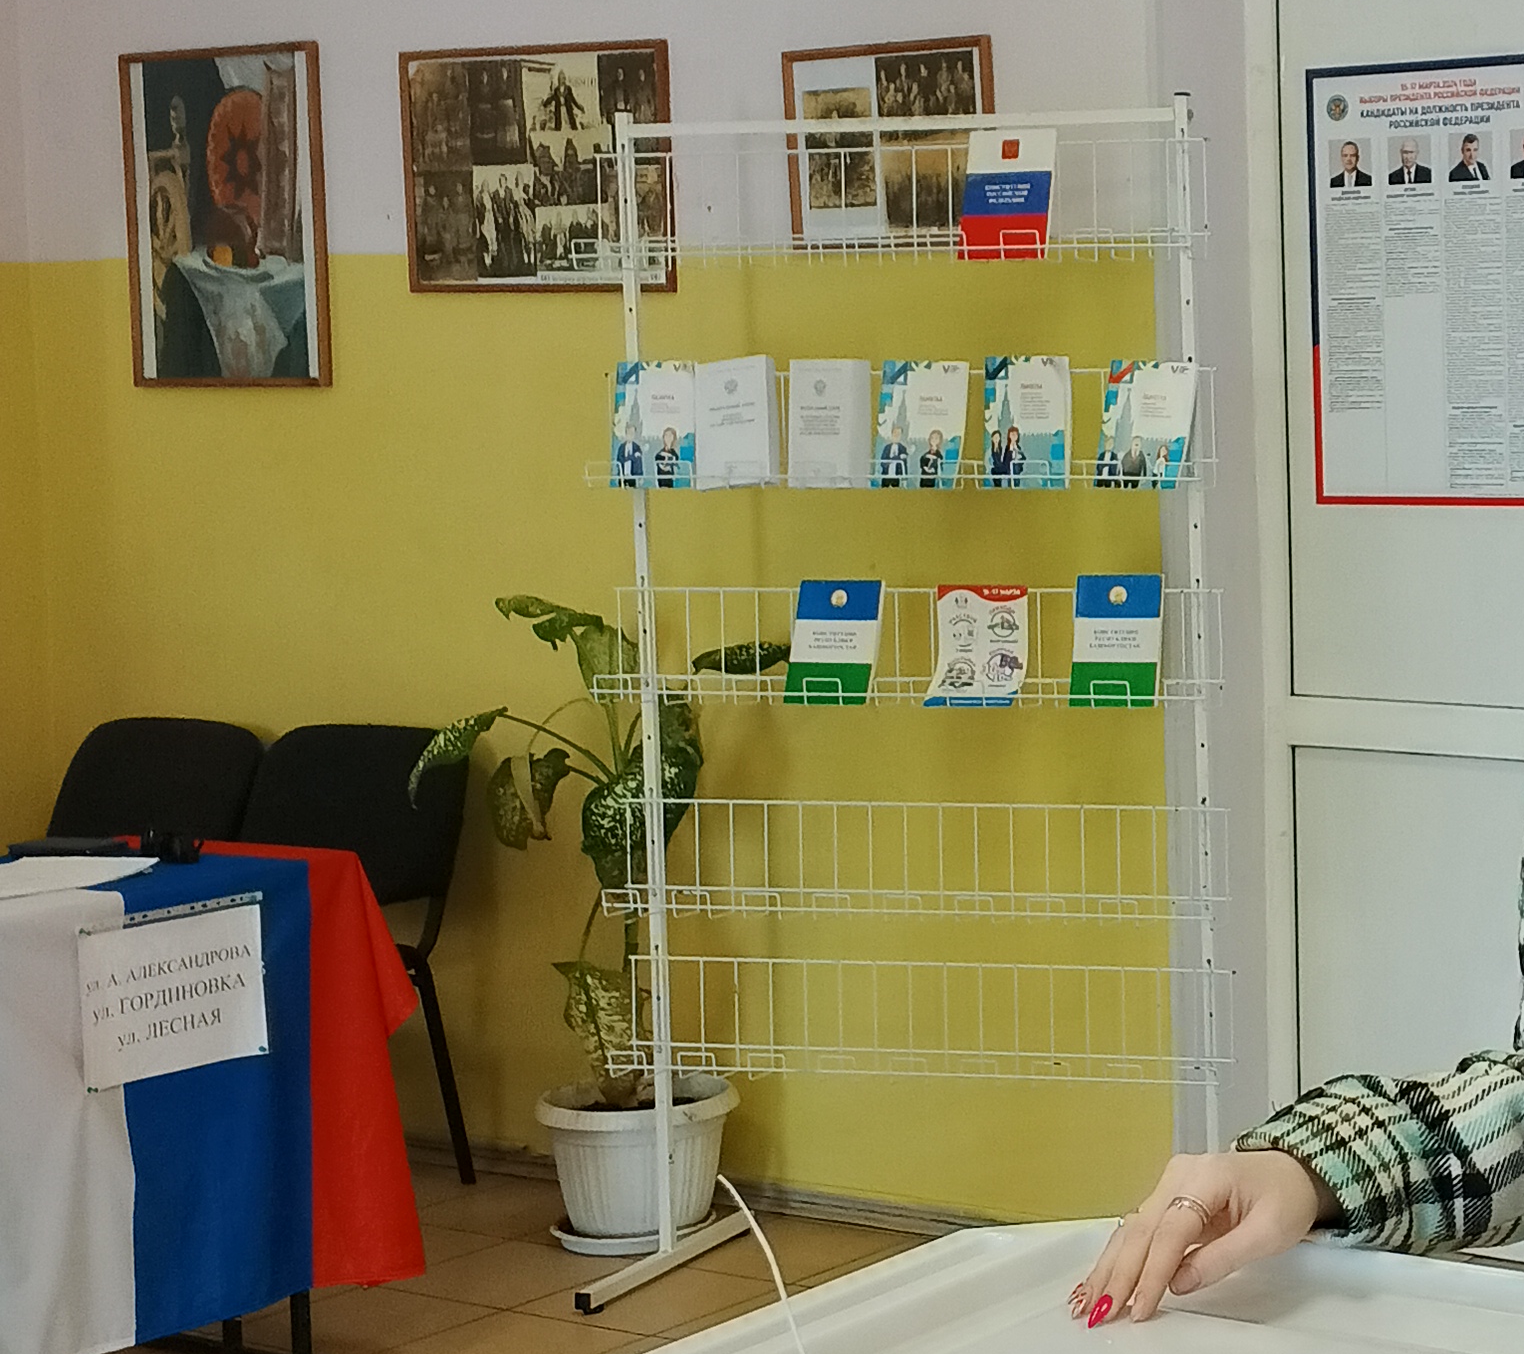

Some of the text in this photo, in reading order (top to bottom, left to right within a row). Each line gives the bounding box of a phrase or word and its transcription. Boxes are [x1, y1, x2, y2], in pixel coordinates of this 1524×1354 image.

[1360, 100, 1521, 119] КАНДИДАТЫ НА ДОЛЖНОСТЬ ПРЕЗИДЕНТА
[1388, 114, 1491, 129] РОССИЙСКОЙ ФЕДЕРАЦИИ
[107, 973, 121, 988] А.
[126, 944, 251, 983] АЛЕКСАНДРОВА
[92, 973, 246, 1027] ул. ГОРДИНОВКА
[116, 1007, 222, 1052] ул. ЛЕСНАЯ
